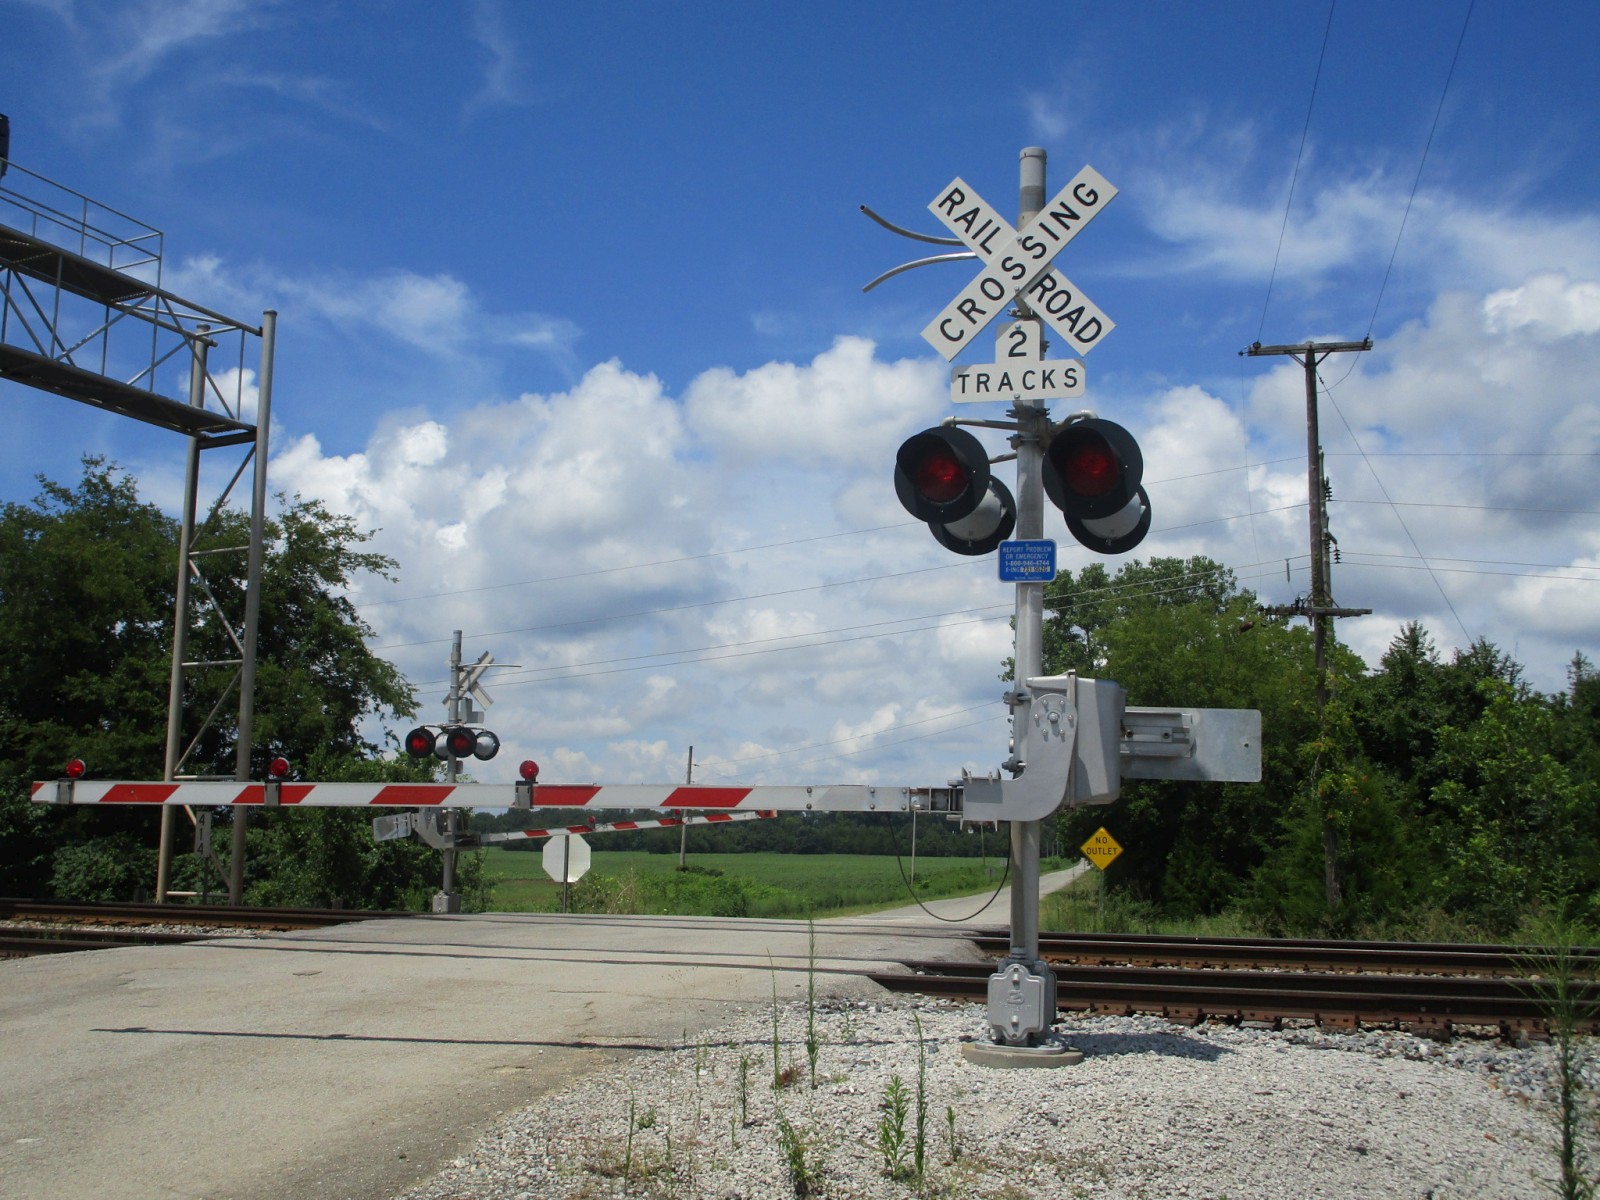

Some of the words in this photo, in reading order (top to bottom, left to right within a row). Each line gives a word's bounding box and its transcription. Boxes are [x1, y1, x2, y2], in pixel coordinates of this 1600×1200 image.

[937, 187, 1001, 255] RAIL
[1028, 272, 1102, 344] ROAD
[939, 182, 1099, 343] CROSSING
[1008, 330, 1027, 358] 2
[957, 367, 1078, 394] TRACKS
[197, 814, 205, 855] 414
[1095, 836, 1108, 844] NO
[1086, 847, 1118, 855] OUTLET
